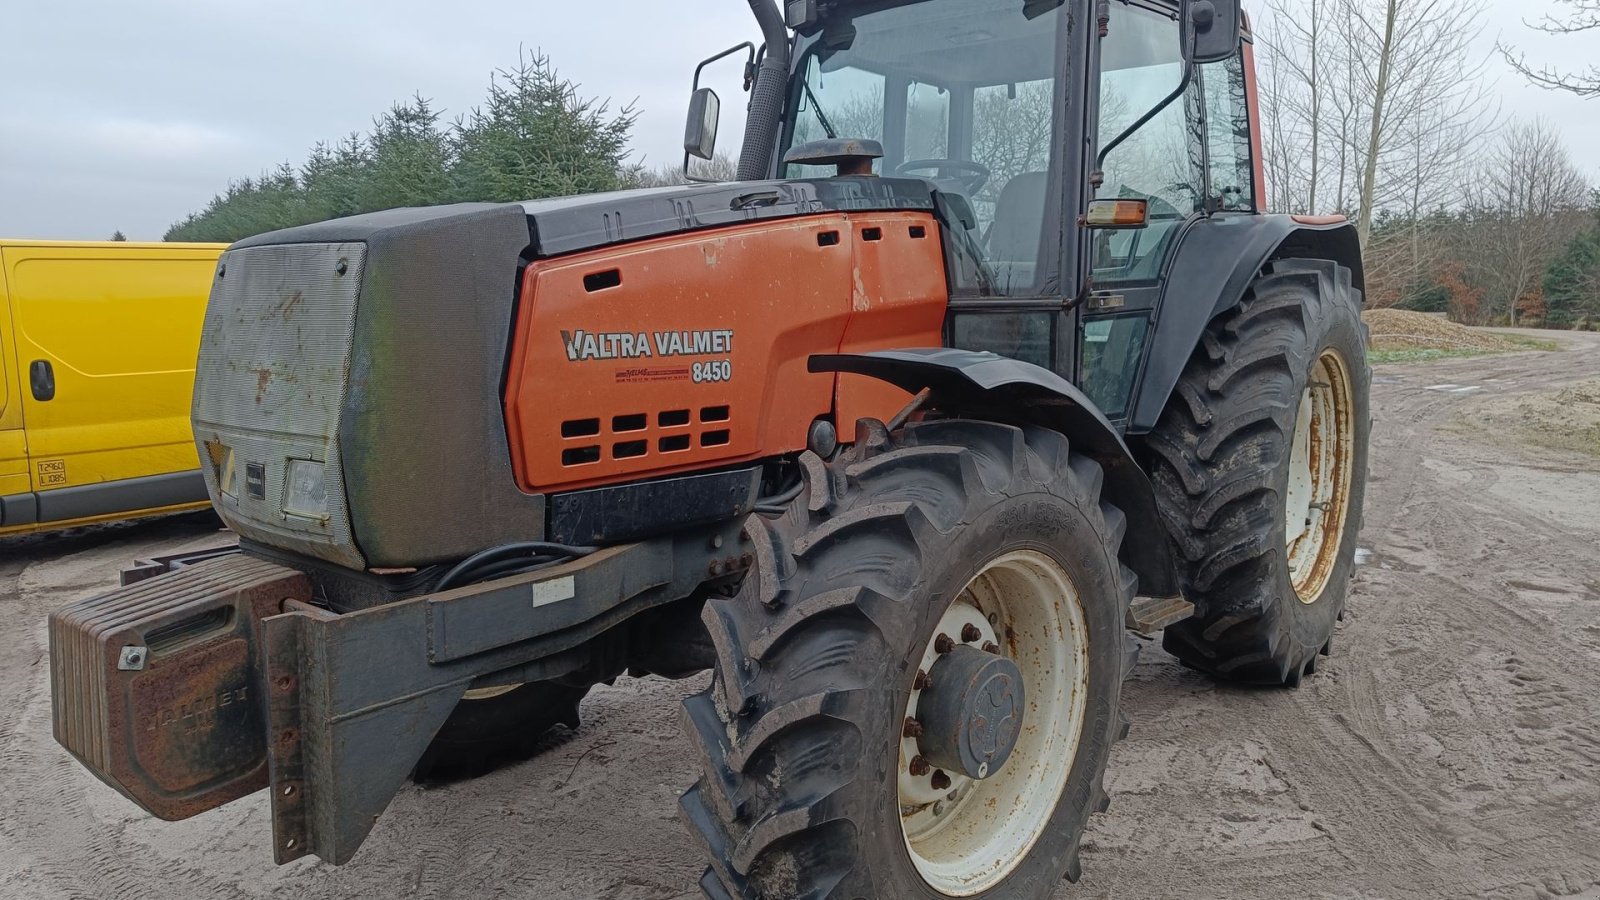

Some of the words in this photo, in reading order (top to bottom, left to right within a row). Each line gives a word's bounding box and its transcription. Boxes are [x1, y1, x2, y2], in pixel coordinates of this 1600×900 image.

[560, 330, 652, 361] VALTRA
[653, 330, 733, 355] VALMET
[692, 360, 732, 384] 8450
[39, 461, 63, 472] T2960
